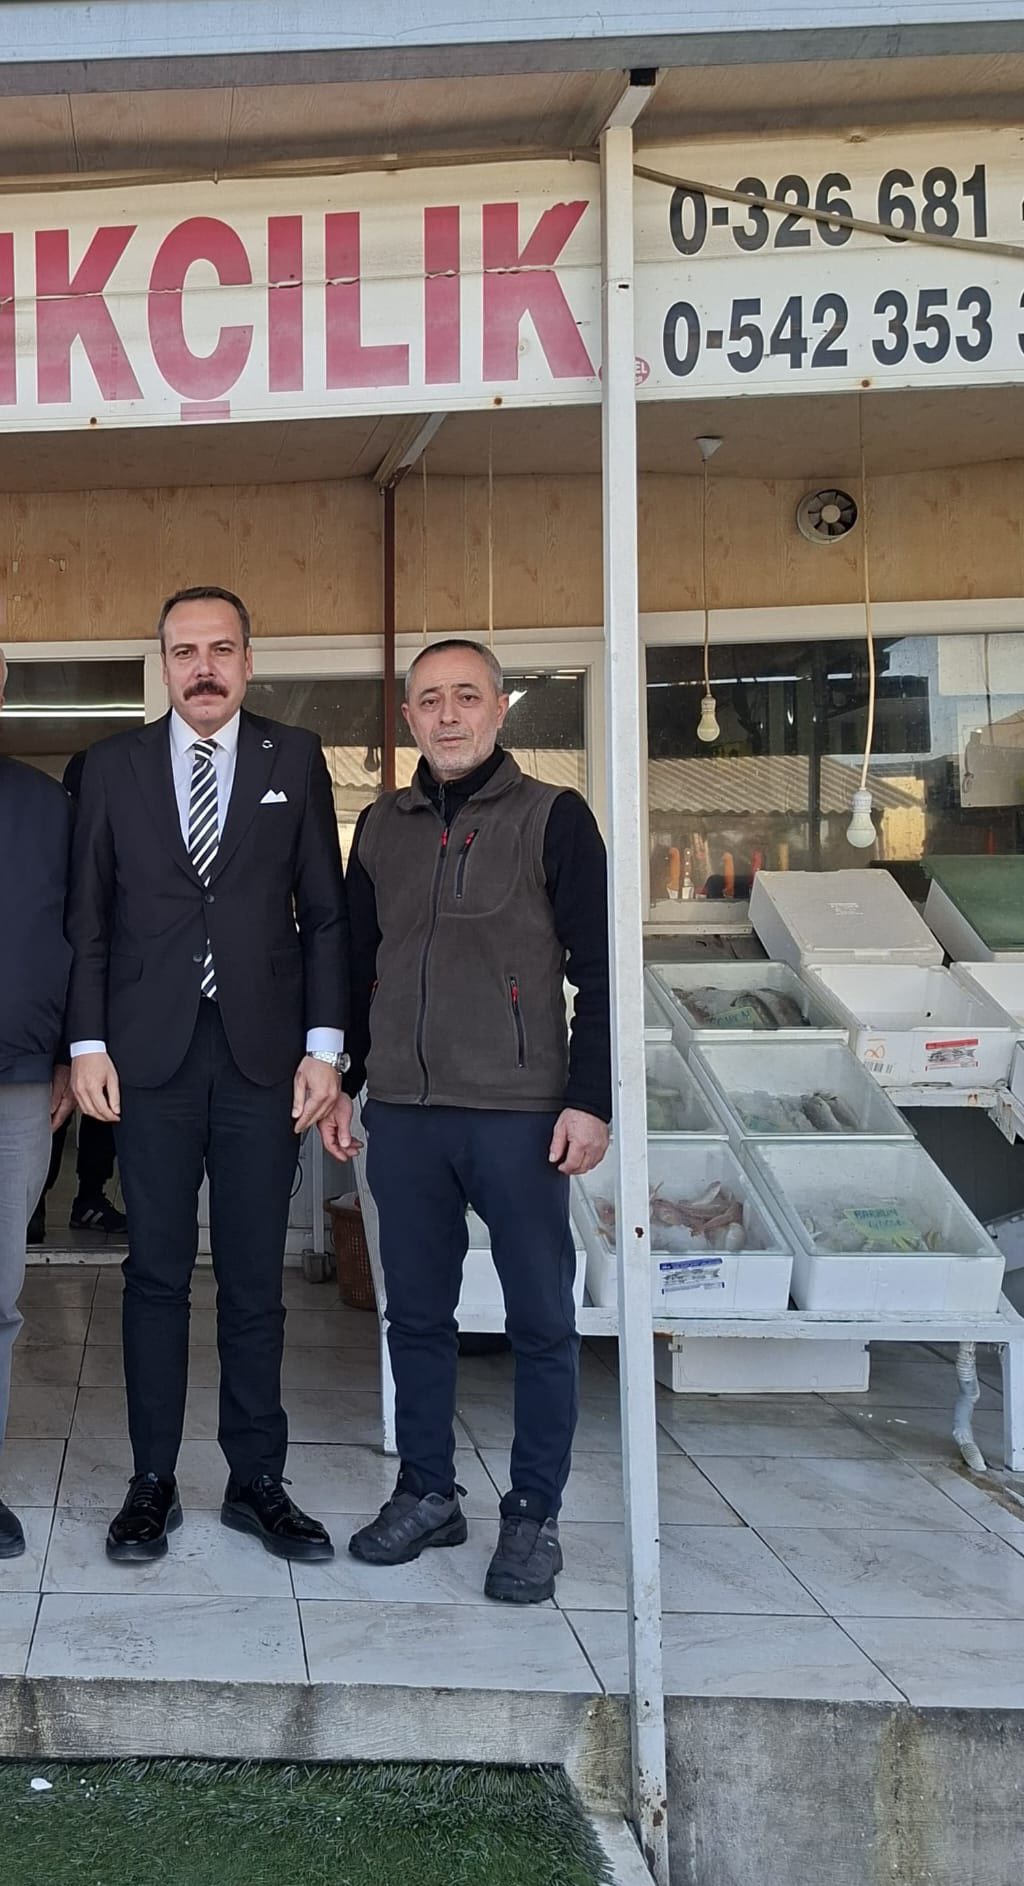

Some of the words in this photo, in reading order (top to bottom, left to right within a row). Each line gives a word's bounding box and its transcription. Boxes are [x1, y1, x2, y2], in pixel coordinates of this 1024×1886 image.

[669, 172, 853, 255] 0-326
[878, 164, 988, 243] 681
[662, 292, 849, 377] 0-542
[872, 286, 993, 366] 353
